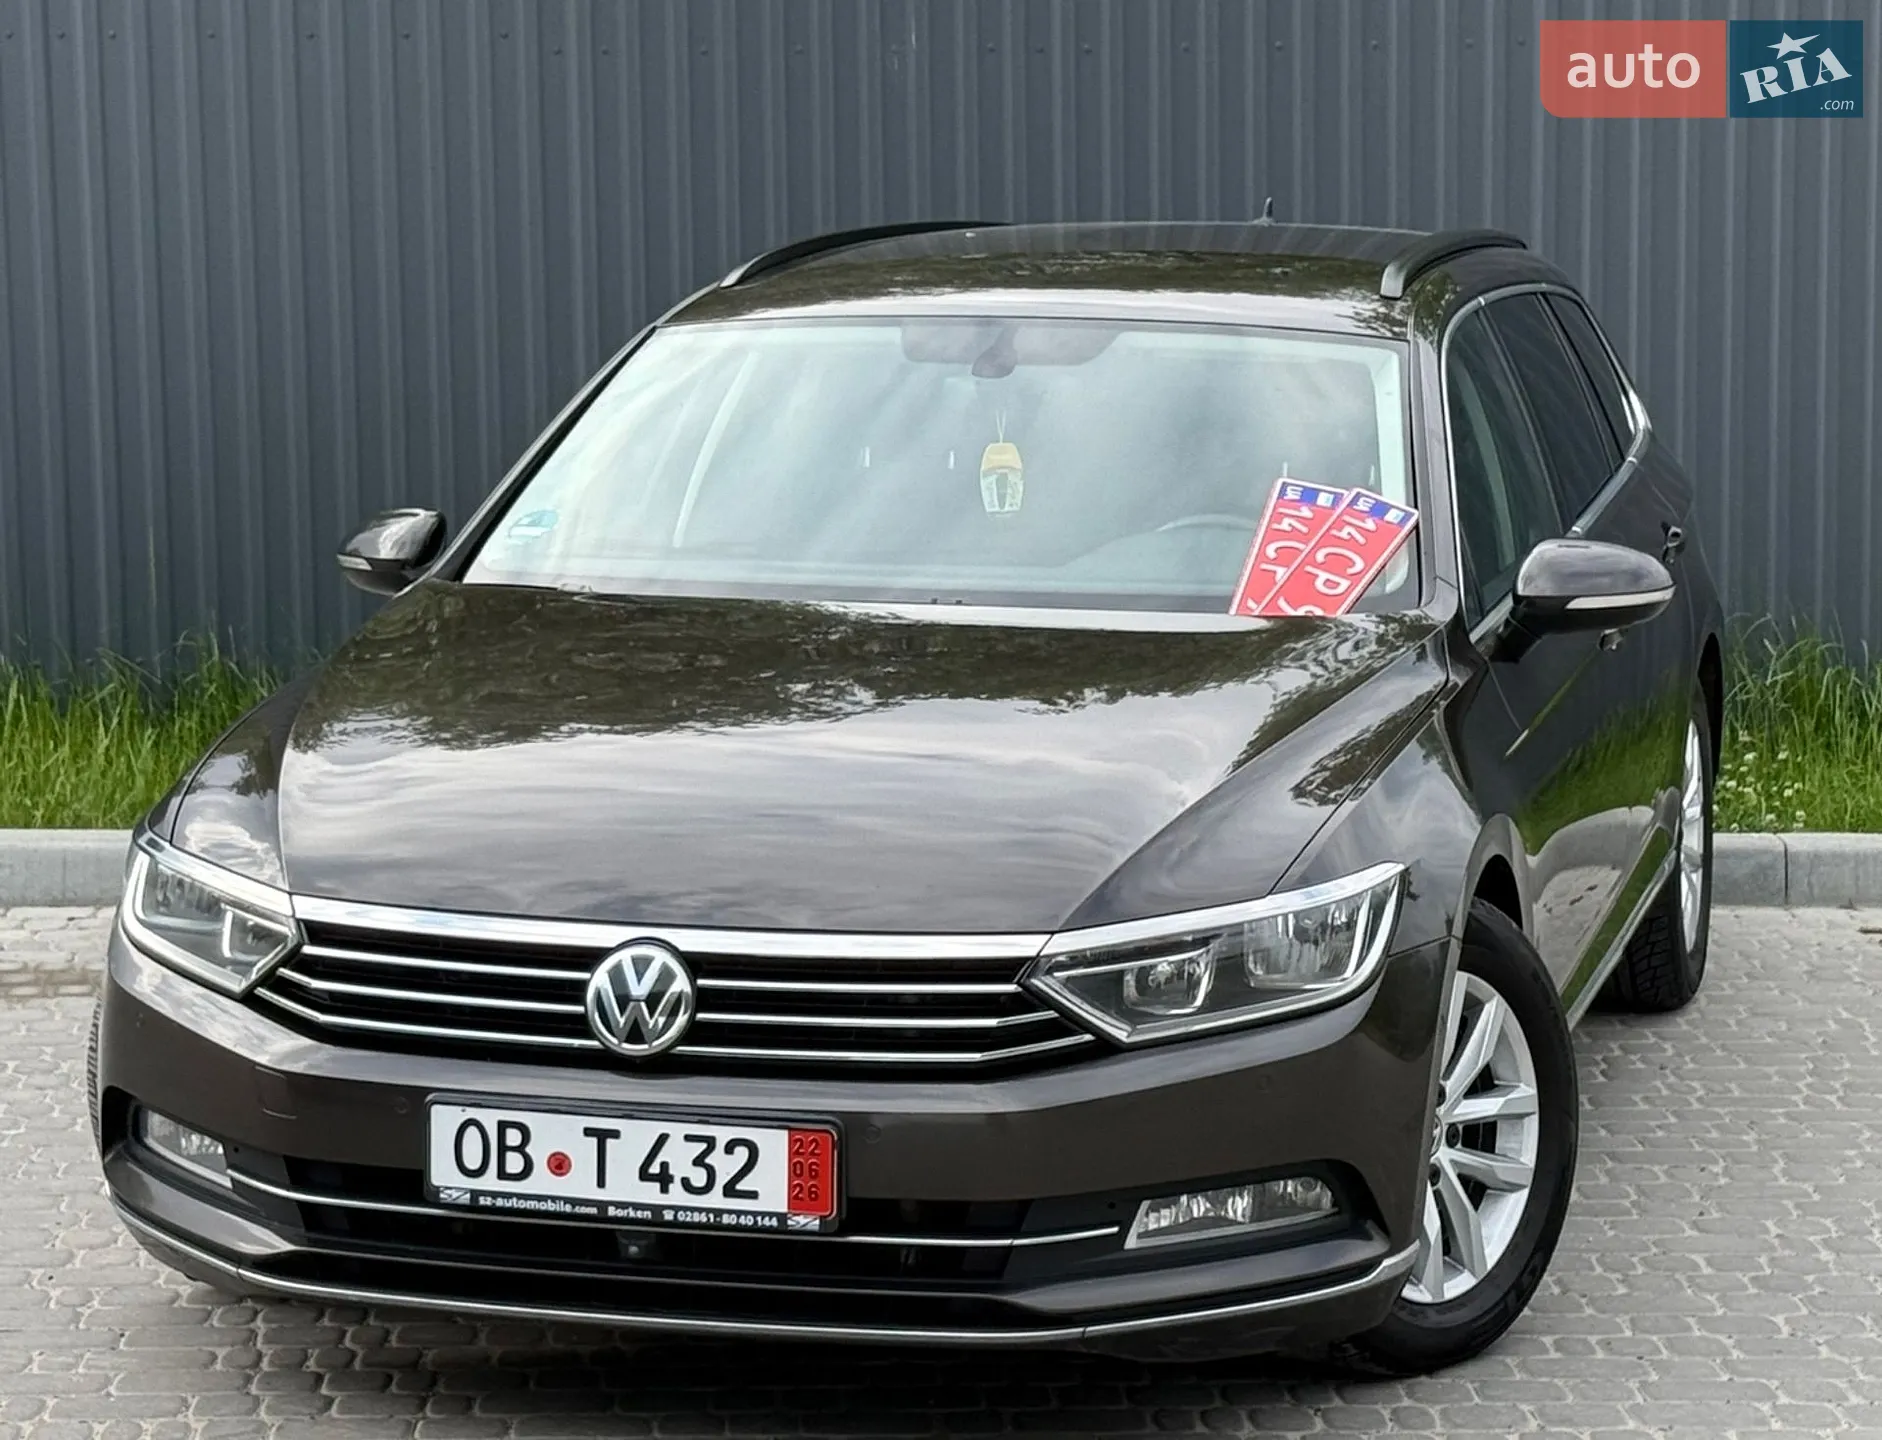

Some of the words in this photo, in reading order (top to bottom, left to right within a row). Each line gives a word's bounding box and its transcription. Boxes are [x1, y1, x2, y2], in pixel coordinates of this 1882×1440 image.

[791, 1135, 822, 1156] 22
[453, 1117, 535, 1182] OB
[583, 1127, 621, 1189] T
[638, 1132, 760, 1201] 432
[791, 1157, 821, 1180] 06
[791, 1180, 821, 1202] 26
[607, 1205, 652, 1220] Borken
